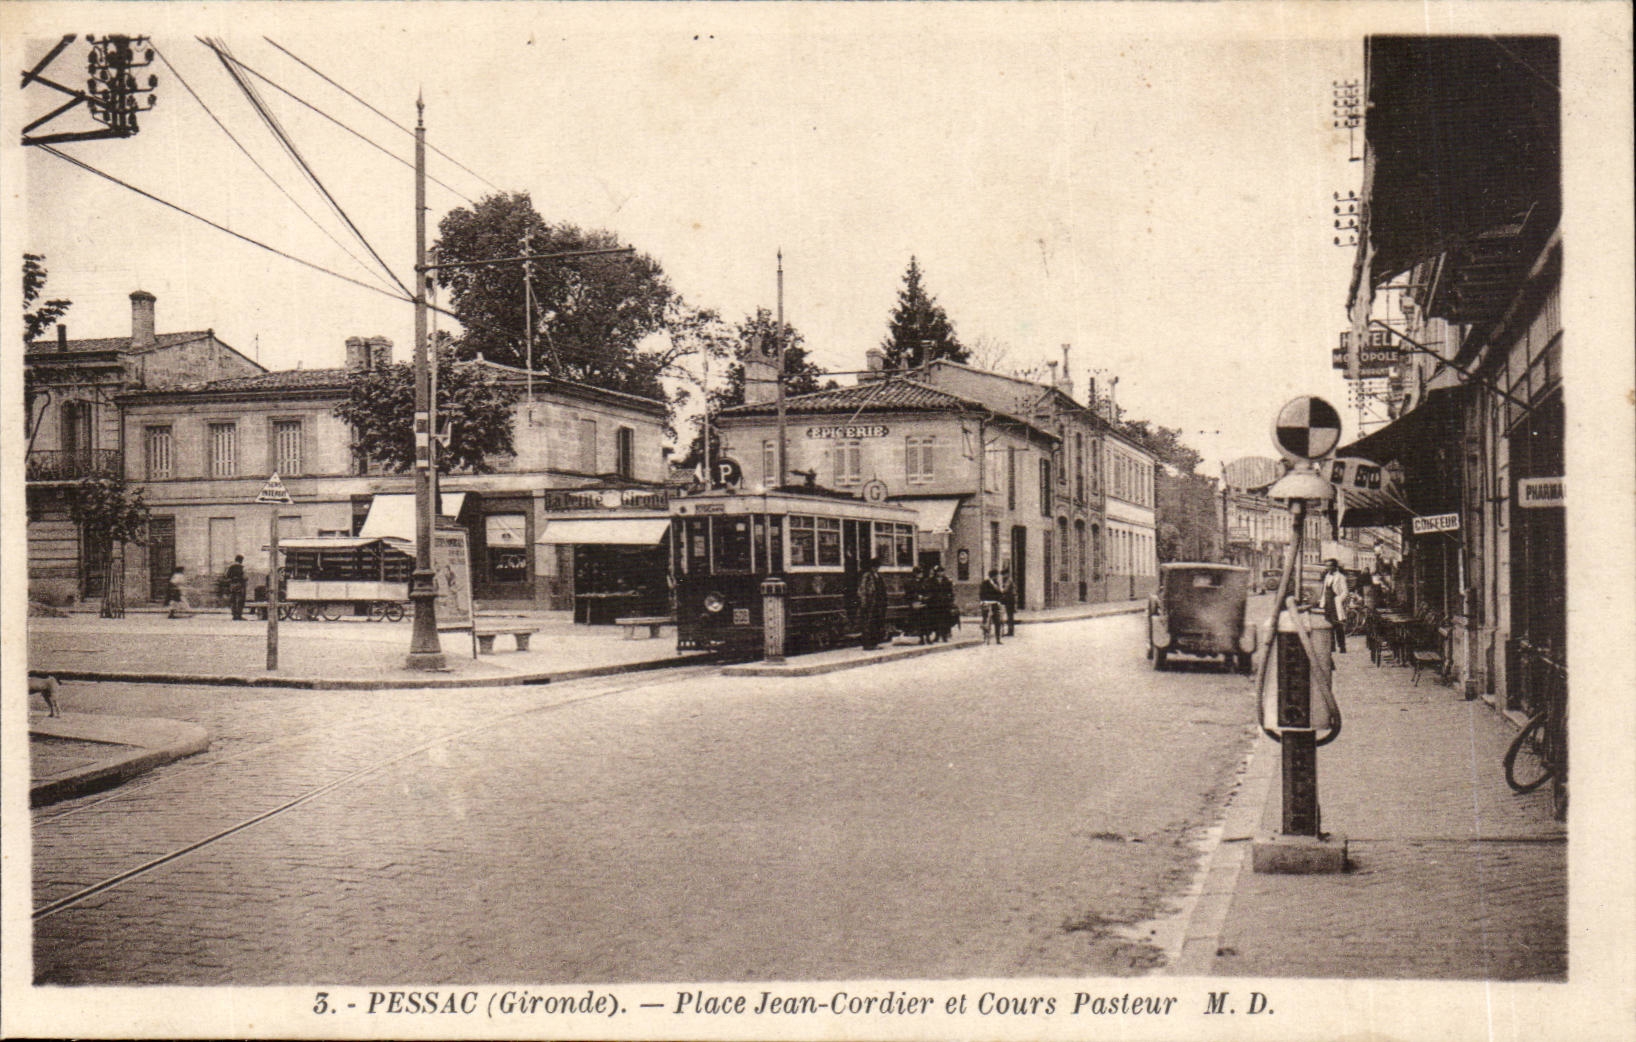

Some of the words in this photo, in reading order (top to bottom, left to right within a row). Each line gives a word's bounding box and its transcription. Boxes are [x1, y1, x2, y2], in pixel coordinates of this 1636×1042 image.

[1333, 352, 1399, 362] MOOPOLE
[719, 464, 733, 484] P
[1414, 516, 1458, 530] COIFFEUR
